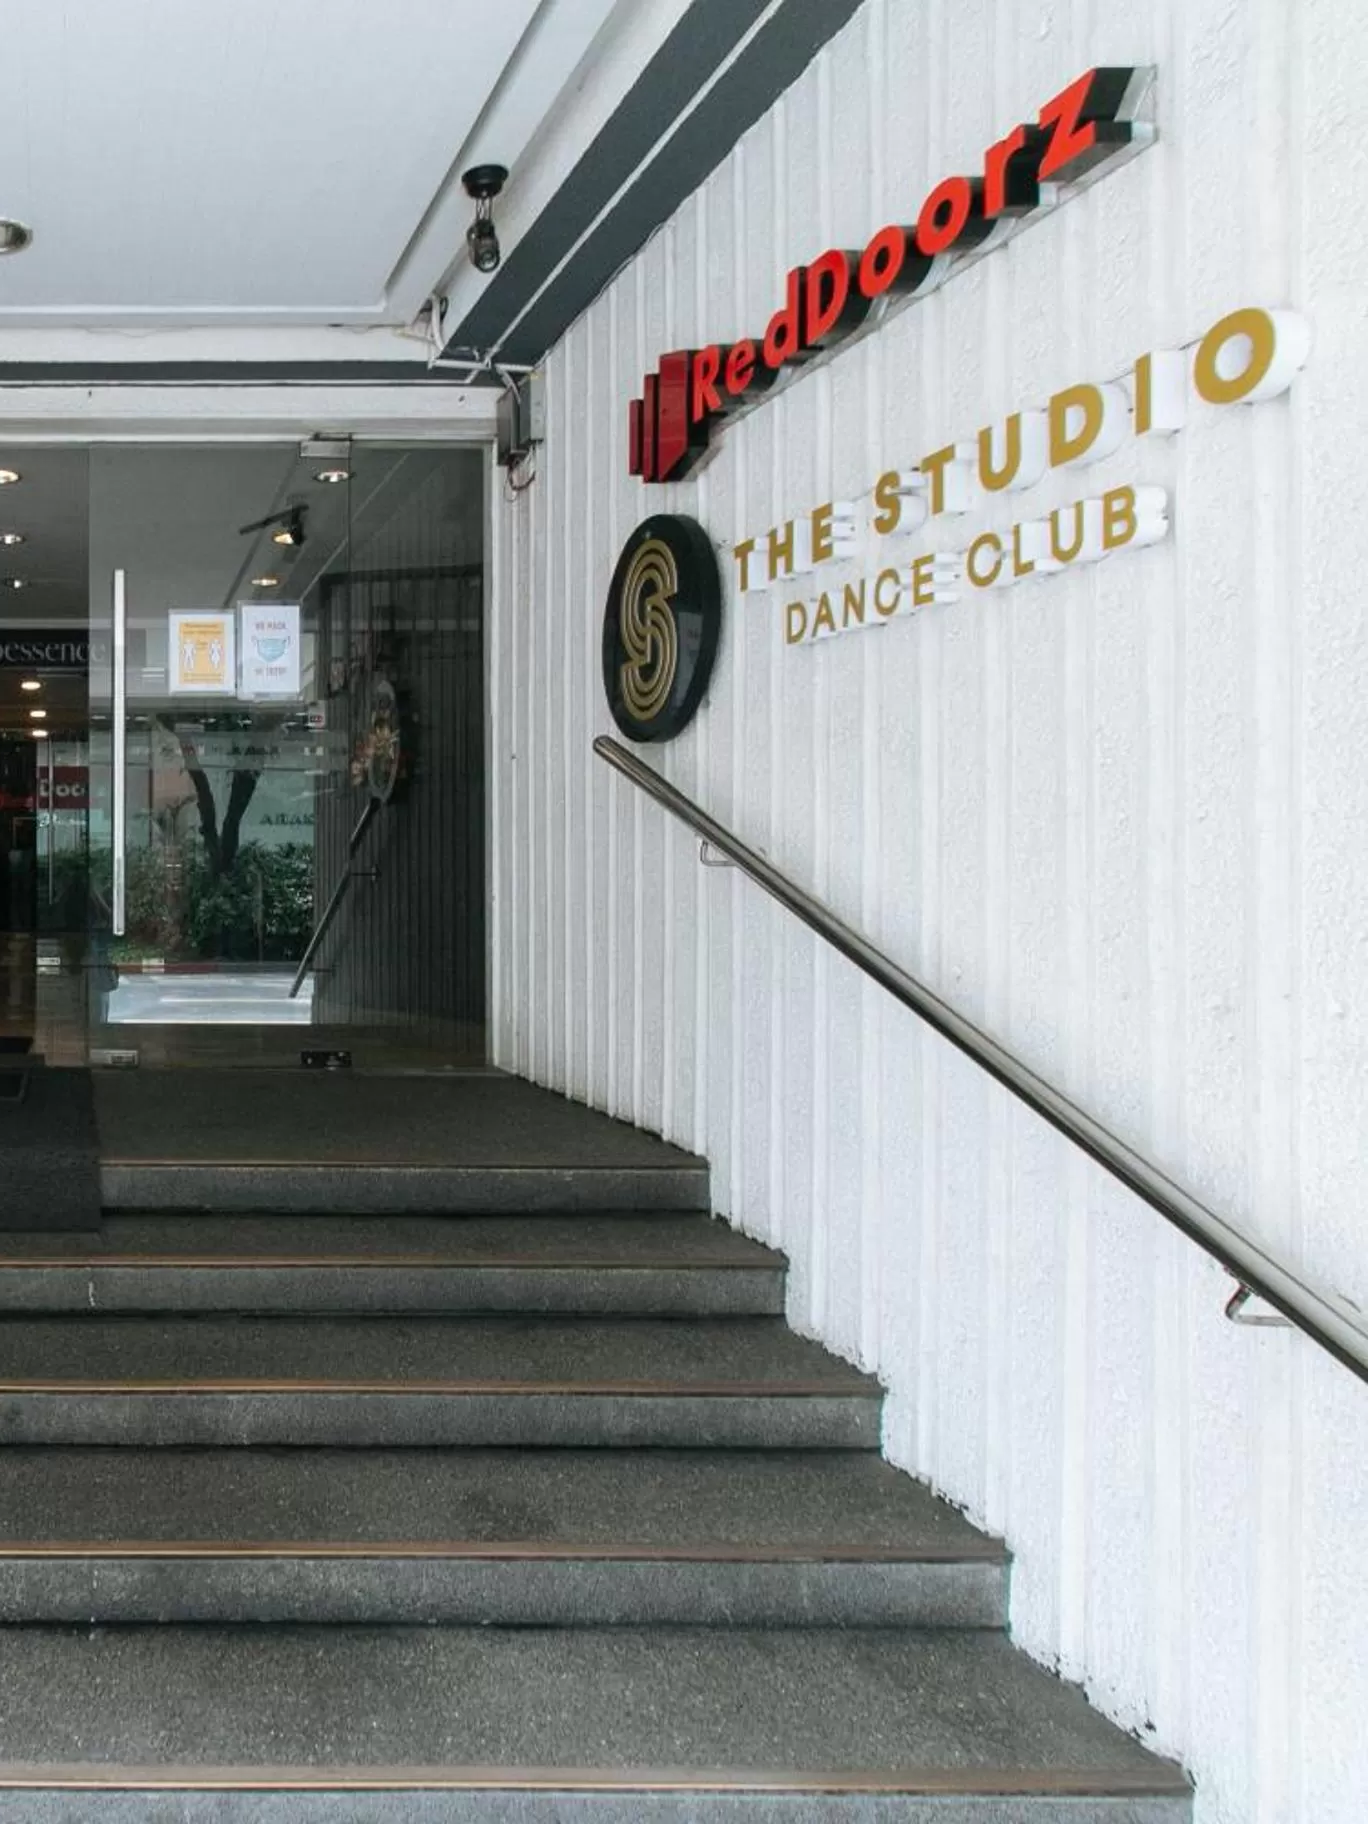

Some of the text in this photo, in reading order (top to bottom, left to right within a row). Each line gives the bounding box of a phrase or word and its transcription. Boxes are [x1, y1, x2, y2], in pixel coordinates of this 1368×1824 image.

[692, 67, 1096, 424] RedDoorz
[734, 307, 1277, 593] THE STUDIO
[785, 484, 1138, 645] DANCE CLUB
